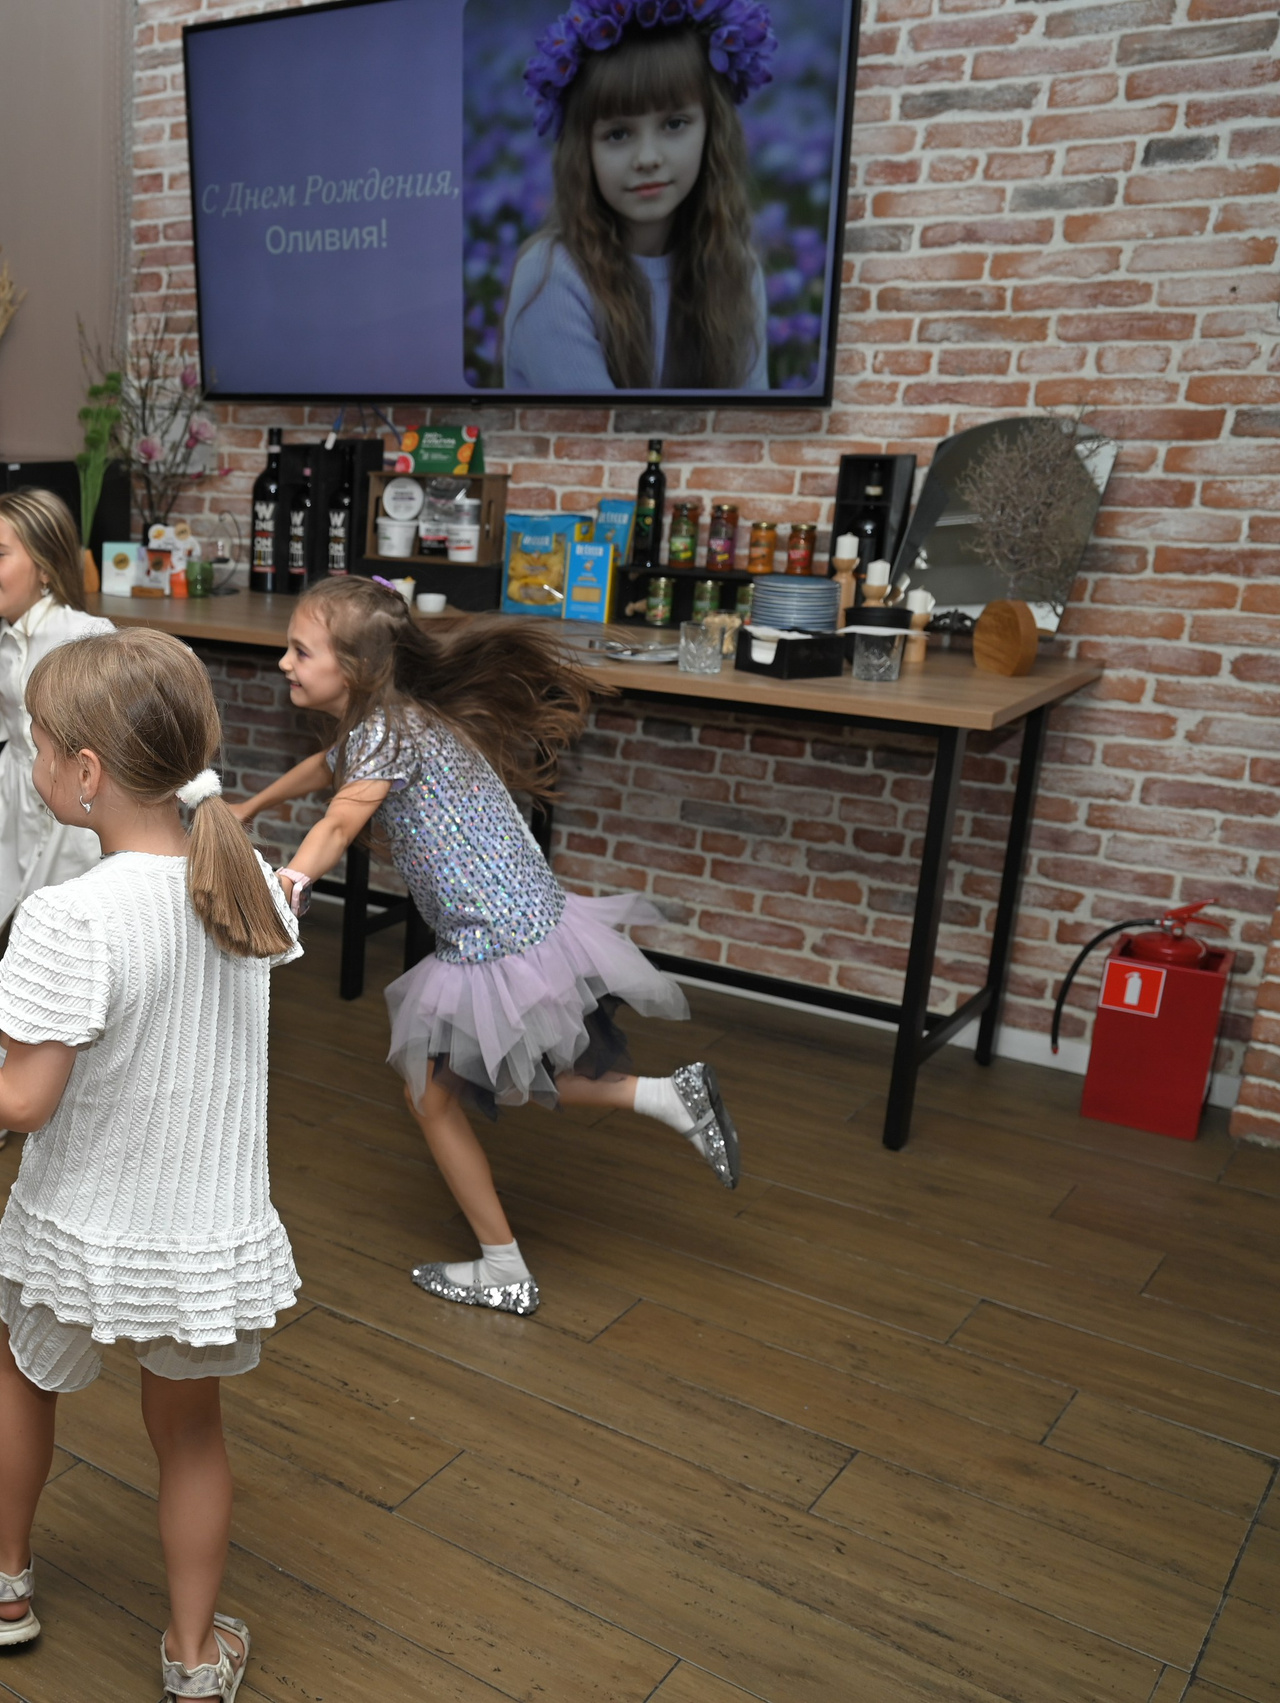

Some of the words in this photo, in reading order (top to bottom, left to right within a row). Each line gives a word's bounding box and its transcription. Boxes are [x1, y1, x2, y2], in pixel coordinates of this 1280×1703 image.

[202, 184, 220, 214] С
[222, 182, 297, 218] Днем
[303, 168, 461, 206] Рождения,
[265, 218, 388, 255] Оливия!
